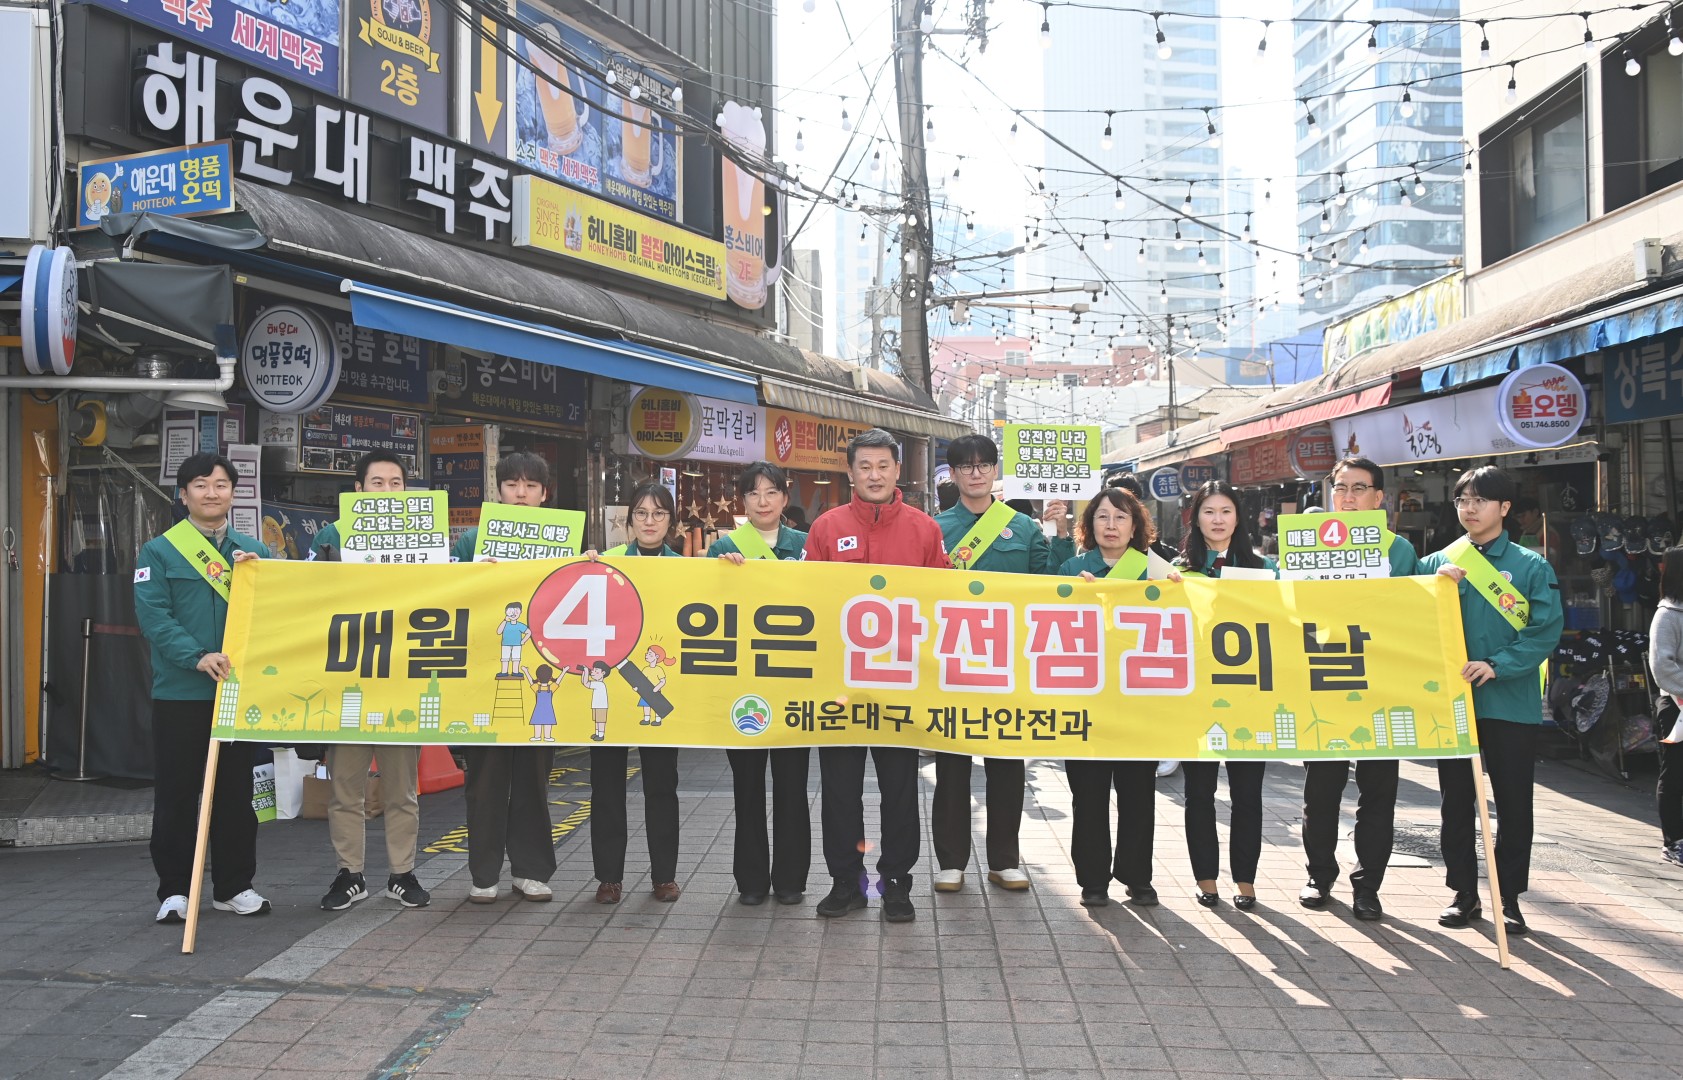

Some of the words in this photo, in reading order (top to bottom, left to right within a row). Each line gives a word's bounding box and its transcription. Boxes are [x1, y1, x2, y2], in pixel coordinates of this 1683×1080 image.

[232, 10, 324, 76] 세계맥주
[377, 27, 397, 42] SOJU
[398, 36, 404, 48] &
[405, 40, 425, 56] BEER
[380, 59, 420, 107] 2층
[143, 42, 370, 204] 해운대
[409, 136, 511, 241] 맥주
[180, 154, 221, 182] 명품
[516, 140, 537, 162] 소주
[540, 148, 559, 172] 맥주
[562, 157, 599, 187] 세계맥주
[130, 162, 176, 197] 해운대
[181, 179, 222, 205] 호떡
[132, 195, 176, 212] HOTTEOK
[536, 197, 559, 212] ORIGINAL
[536, 208, 560, 222] SINCE
[536, 220, 560, 241] 2018
[588, 215, 637, 255] 허니홈비
[724, 224, 763, 260] 홍스비어
[588, 242, 627, 262] HONEYHOMB
[629, 255, 655, 271] ORIGINAL
[657, 263, 690, 280] HONEYCOMB
[691, 273, 716, 288] ICECREAM
[738, 261, 752, 281] 2F
[267, 321, 299, 336] 해운대
[252, 341, 311, 369] 명품호떡
[335, 321, 376, 364] 명품
[382, 333, 420, 371] 호떡
[256, 374, 303, 386] HOTTEOK
[351, 371, 368, 388] 맛을
[370, 373, 413, 393] 추구합니다.
[477, 354, 557, 394] 홍스비어
[472, 392, 507, 408] 해운대에서
[1512, 393, 1578, 419] 불오뎅
[335, 413, 352, 427] 해운대
[568, 402, 580, 421] 2F
[644, 411, 676, 430] 벌집
[703, 405, 756, 443] 꿀막걸리
[1521, 420, 1570, 429] 051.746.8500
[636, 430, 683, 443] 아이스크림
[1018, 429, 1057, 445] 안전한
[1061, 430, 1087, 446] 나라
[718, 445, 745, 457] Makgeolli
[795, 452, 820, 464] Honeycomb
[1018, 445, 1058, 462] 행복한
[1061, 447, 1087, 462] 국민
[1015, 463, 1091, 478] 안전점검으로
[1038, 482, 1081, 493] 해운대구
[352, 498, 403, 514] 4고없는
[406, 496, 434, 513] 일터
[353, 516, 405, 532] 4고없는
[407, 515, 434, 531] 가정
[487, 519, 541, 541] 안전사고
[543, 525, 570, 542] 예방
[346, 534, 369, 550] 4일
[370, 532, 445, 550] 안전점검으로
[1286, 529, 1316, 547] 매월
[1324, 522, 1341, 544] 4
[1350, 526, 1380, 544] 일은
[380, 553, 429, 563] 해운대구
[482, 539, 521, 559] 기본만
[1285, 548, 1362, 570] 안전점검의
[1364, 548, 1382, 567] 날
[325, 608, 470, 679] 매월
[544, 574, 616, 656] 4
[677, 603, 817, 678] 일은
[840, 594, 1273, 697] 안전점검의
[1303, 622, 1371, 691] 날
[785, 700, 914, 732] 해운대구
[926, 706, 1093, 741] 재난안전과
